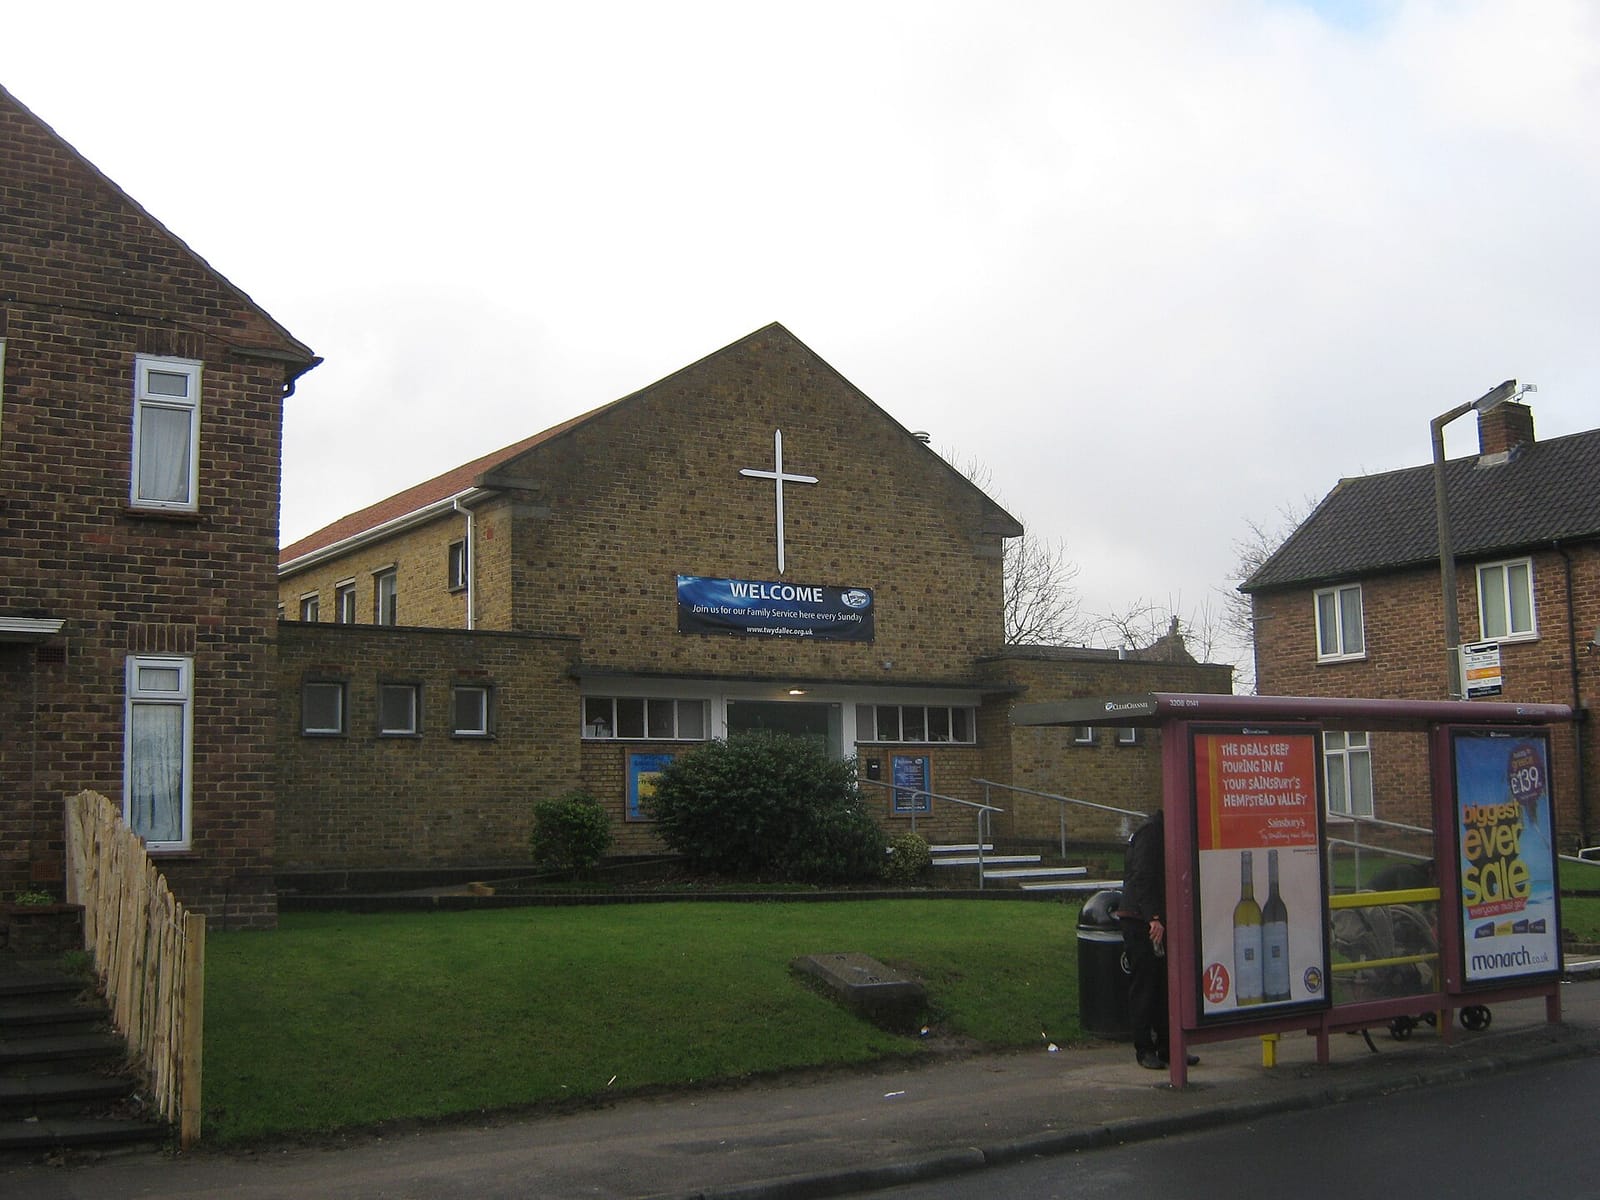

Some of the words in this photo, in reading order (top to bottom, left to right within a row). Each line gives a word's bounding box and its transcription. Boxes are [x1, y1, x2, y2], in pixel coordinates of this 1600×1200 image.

[730, 583, 823, 602] WELCOME
[692, 605, 709, 614] Join
[720, 606, 731, 614] for
[747, 608, 770, 617] Family
[772, 609, 798, 618] Service
[799, 610, 815, 619] here
[817, 613, 836, 621] every
[838, 612, 862, 623] Sunday
[747, 626, 813, 636] www.twydallec.org.uk
[1221, 743, 1238, 756] THE
[1240, 743, 1269, 755] DEALS
[1270, 743, 1290, 756] KEEP
[1222, 759, 1260, 773] POURING
[1261, 759, 1272, 772] IN
[1274, 761, 1284, 772] AT
[1223, 778, 1247, 790] YOUR
[1248, 776, 1301, 790] SAINSBURY'S
[1224, 792, 1276, 807] HEMPSTEAD
[1278, 793, 1308, 806] VALLEY
[1463, 800, 1520, 827] biggest
[1267, 817, 1305, 830] Sainsbury's
[1465, 823, 1523, 860] ever
[1462, 857, 1531, 907] sale
